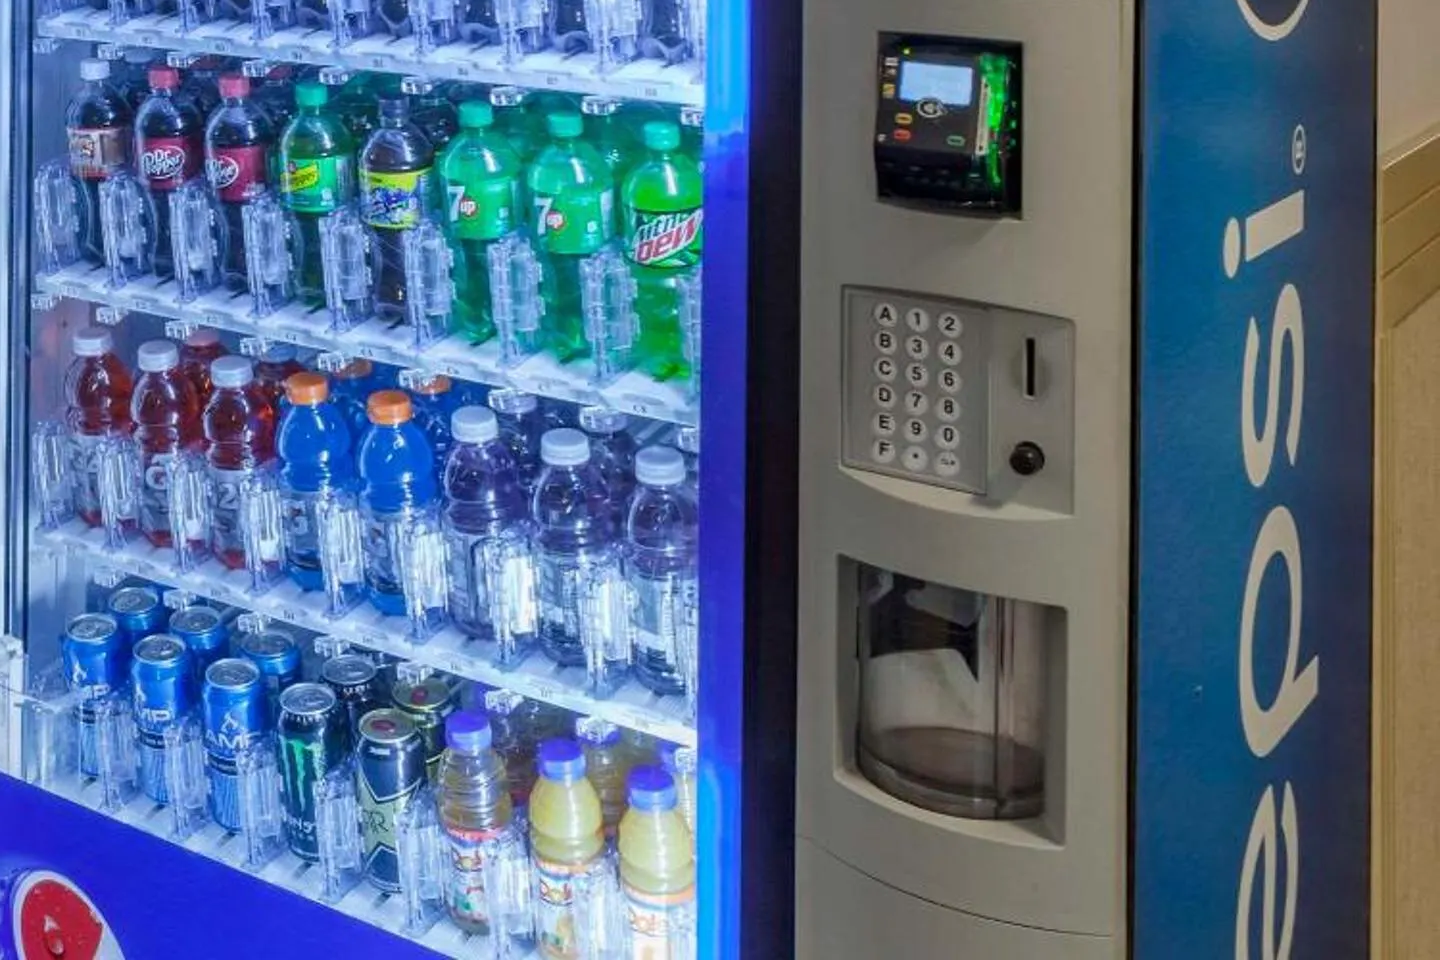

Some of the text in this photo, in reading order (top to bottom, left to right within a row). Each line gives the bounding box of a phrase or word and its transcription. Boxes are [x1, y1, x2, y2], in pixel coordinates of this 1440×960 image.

[879, 307, 955, 331] A 1 2
[880, 333, 954, 359] B 3 4
[879, 360, 954, 387] C 5 6
[879, 387, 954, 414] D 7 8
[879, 415, 953, 442] E 9 0
[879, 442, 890, 456] F
[1222, 189, 1319, 960] epsi
